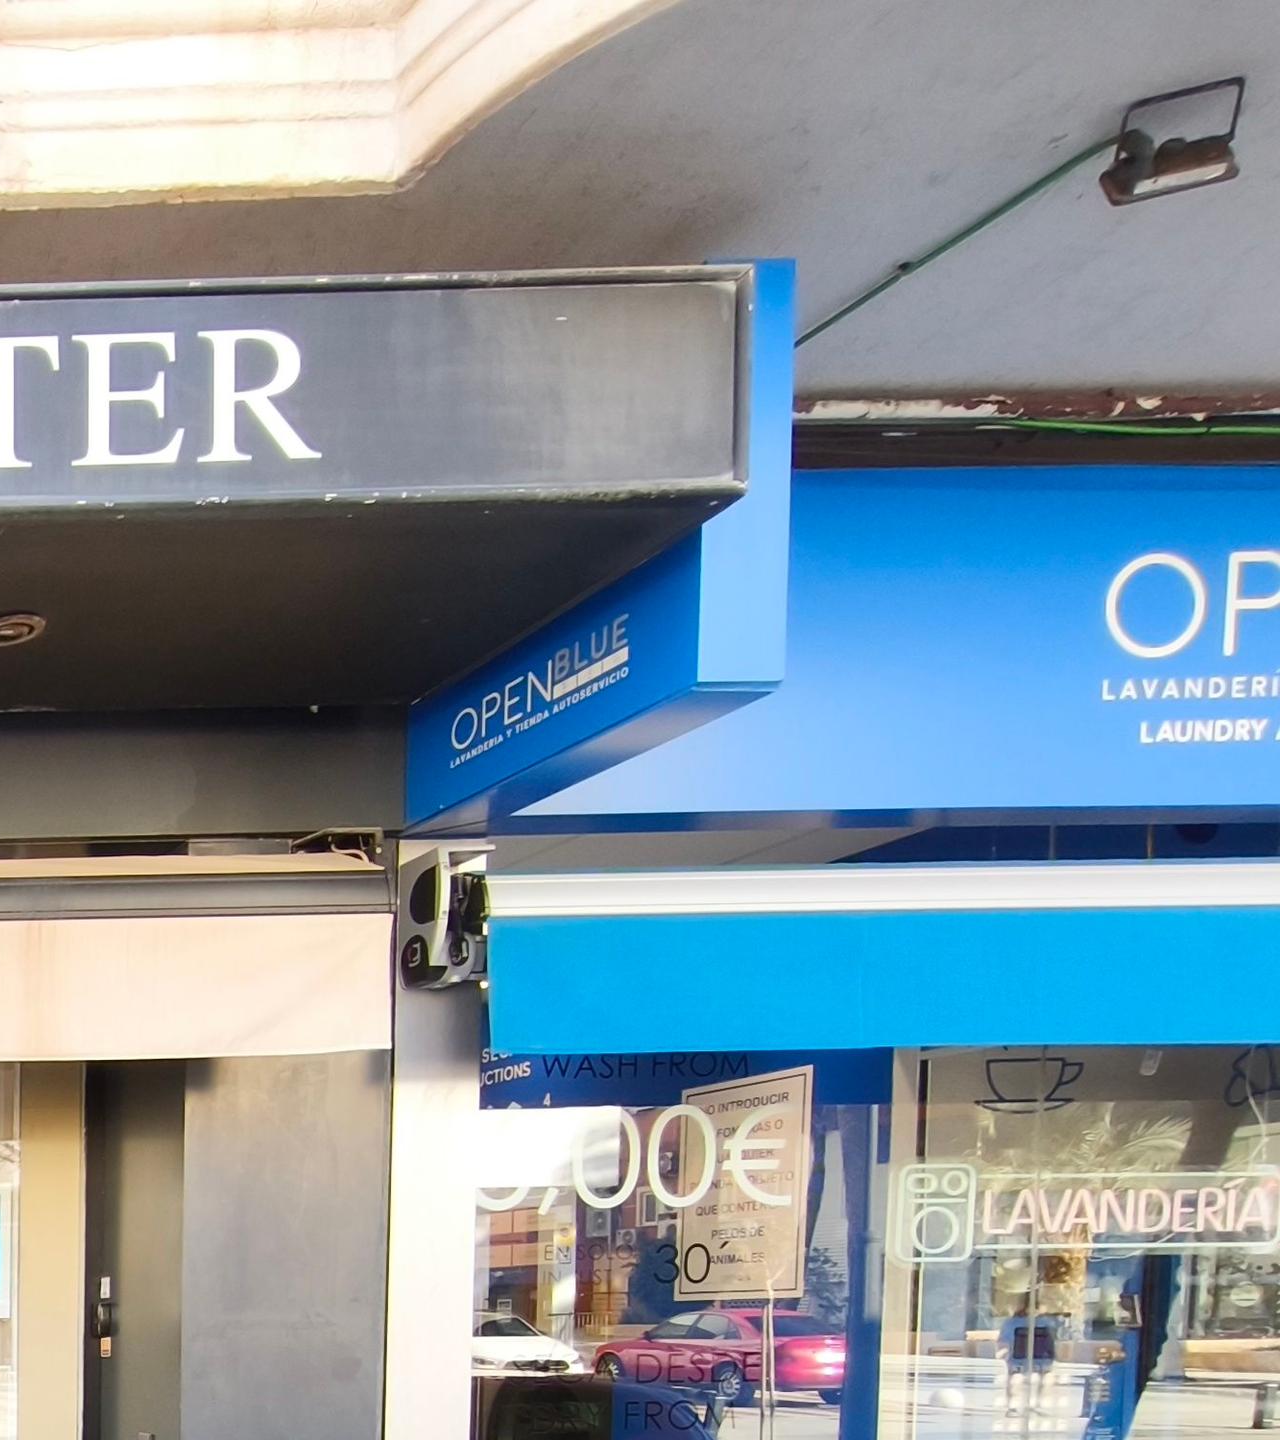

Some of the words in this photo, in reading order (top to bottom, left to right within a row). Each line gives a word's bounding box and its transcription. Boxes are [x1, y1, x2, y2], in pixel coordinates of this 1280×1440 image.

[1140, 718, 1268, 744] LAUNDRY
[541, 1055, 639, 1080] WASH
[652, 1052, 749, 1078] FROM
[718, 1091, 790, 1114] INTRODUCIR
[695, 1203, 718, 1217] QUE
[981, 1178, 1272, 1235] LAVANDERÍA
[711, 1226, 748, 1241] PELOS
[710, 1252, 766, 1266] ANIMALES
[635, 1351, 762, 1384] DESDE
